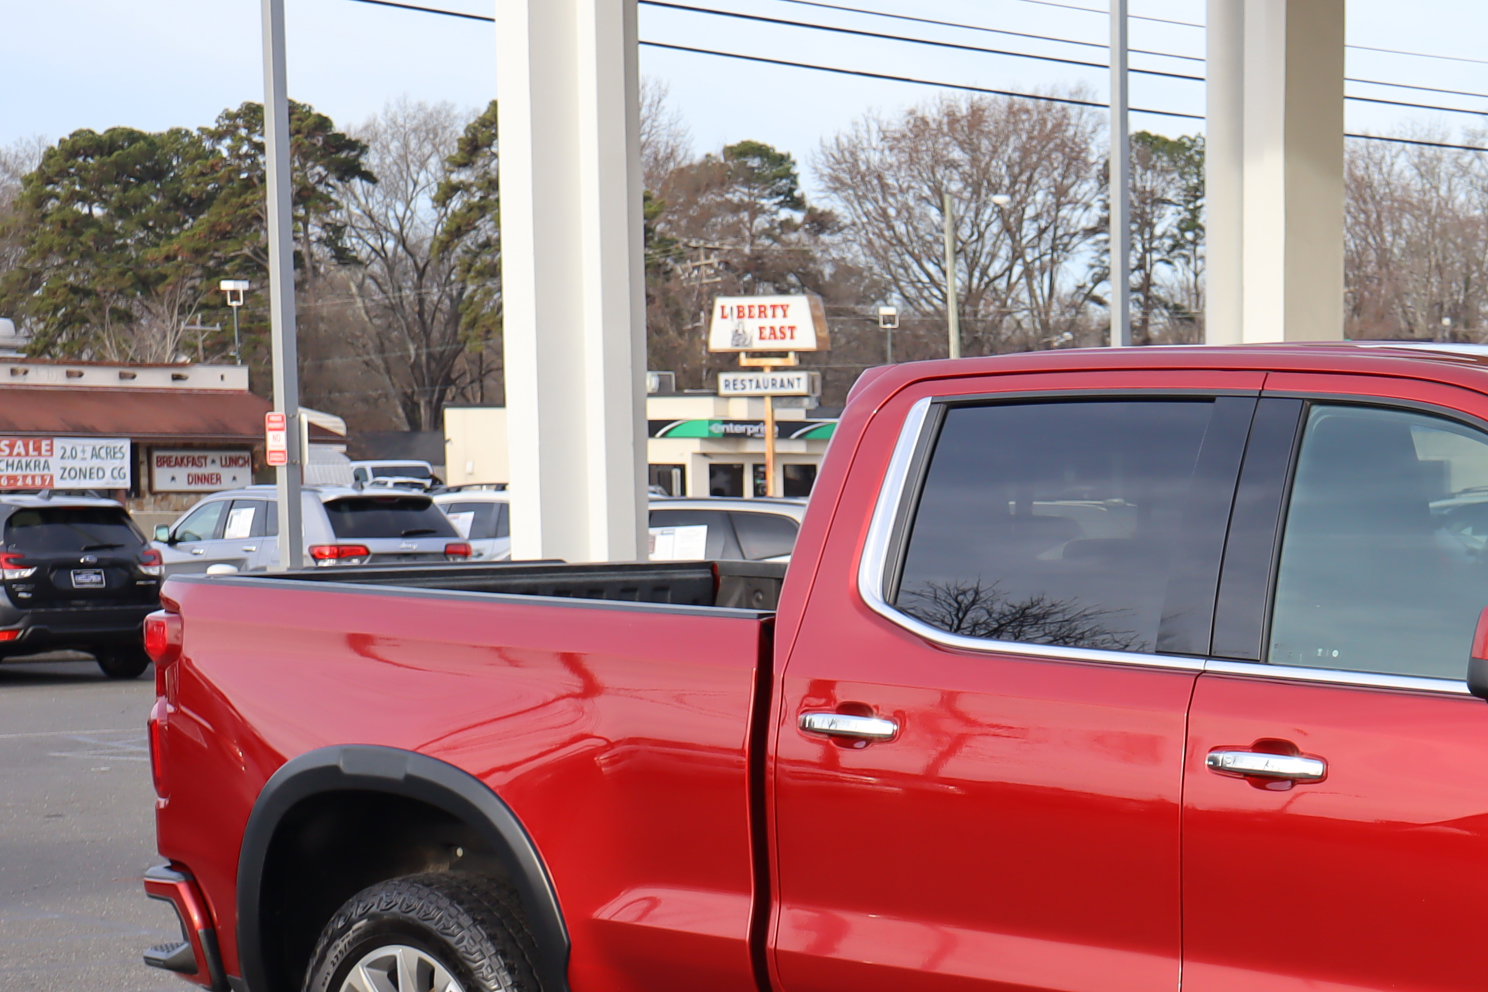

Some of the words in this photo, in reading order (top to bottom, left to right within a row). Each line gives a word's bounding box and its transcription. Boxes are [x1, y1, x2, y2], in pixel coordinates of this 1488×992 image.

[720, 303, 790, 320] LIBERTY
[758, 325, 797, 341] EAST
[724, 376, 802, 391] RESTAURANT
[0, 440, 51, 456] SALE
[60, 446, 78, 460] 2.0
[90, 445, 126, 460] ACRES
[155, 455, 209, 468] BREAKFAST
[220, 455, 250, 468] LUNCH
[60, 466, 106, 481] ZONED
[110, 466, 127, 480] CG
[187, 472, 222, 485] DINNER
